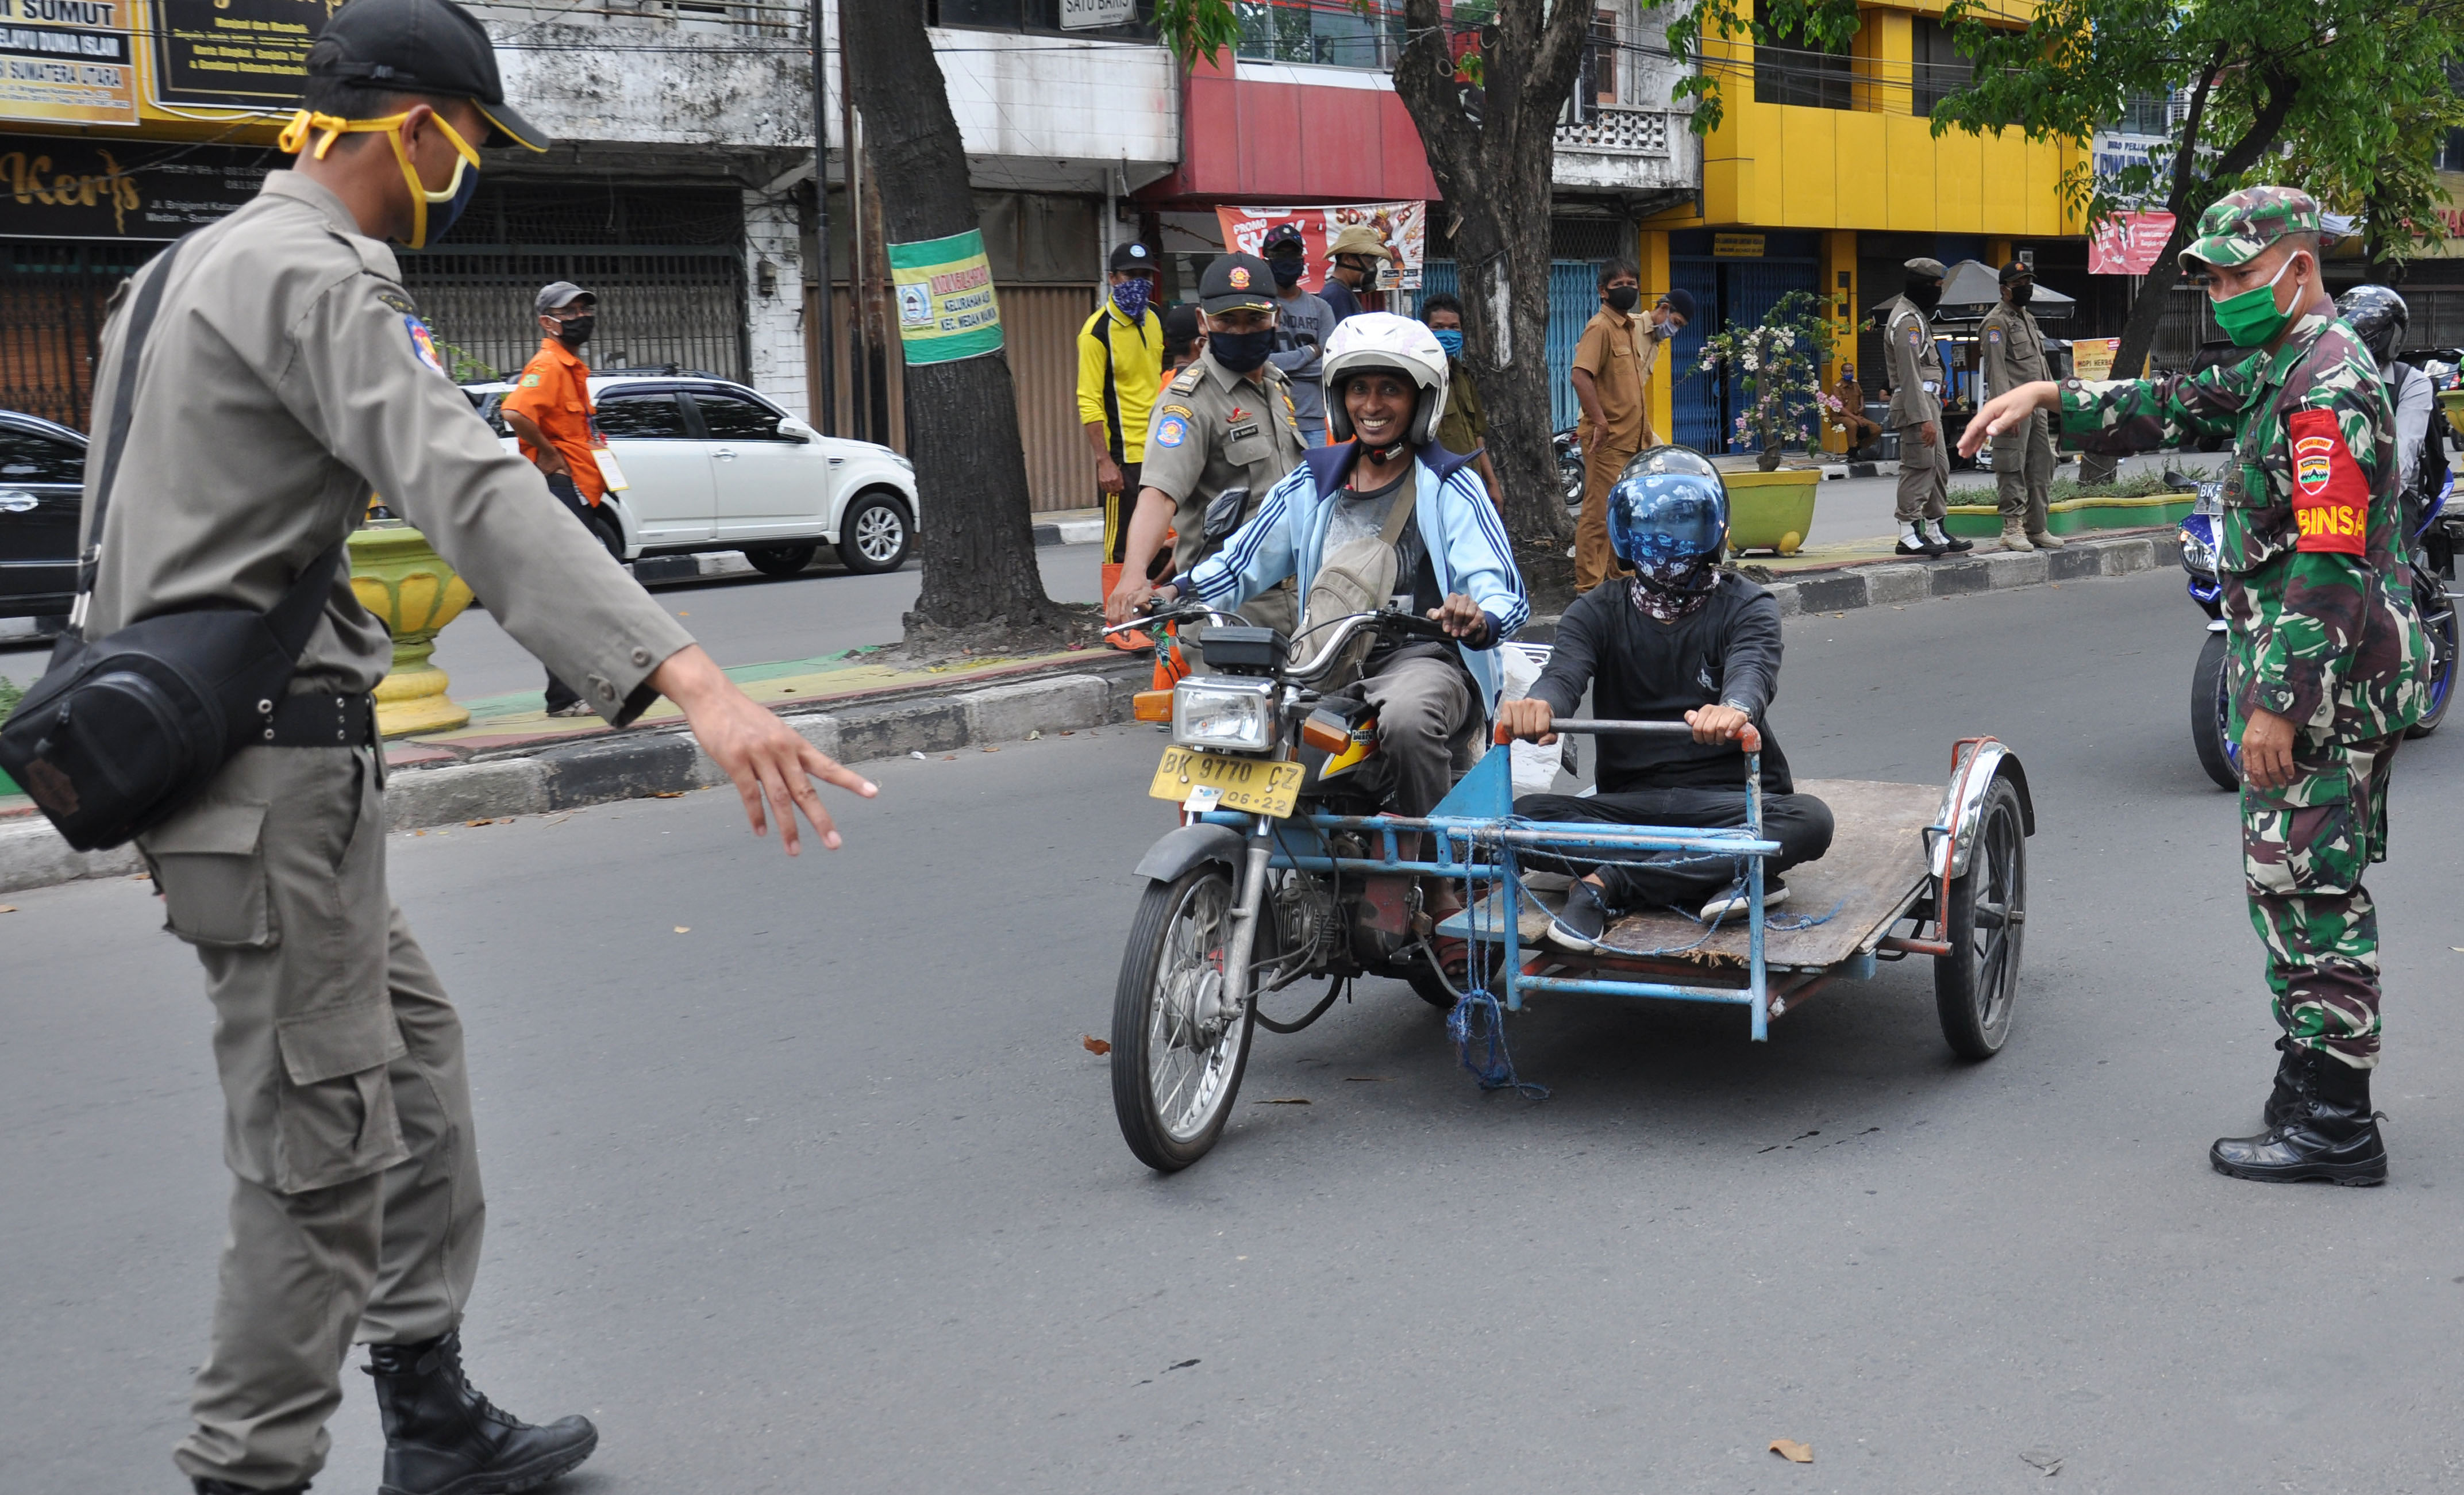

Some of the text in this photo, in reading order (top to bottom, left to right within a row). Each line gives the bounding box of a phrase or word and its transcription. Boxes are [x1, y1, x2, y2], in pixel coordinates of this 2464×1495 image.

[24, 0, 114, 26] SUMUT
[10, 60, 78, 84] SUMATERA
[80, 66, 122, 87] UTARA
[1233, 218, 1268, 235] PROMO
[2200, 485, 2216, 497] BK
[1163, 752, 1299, 789] BK 9770 CZ
